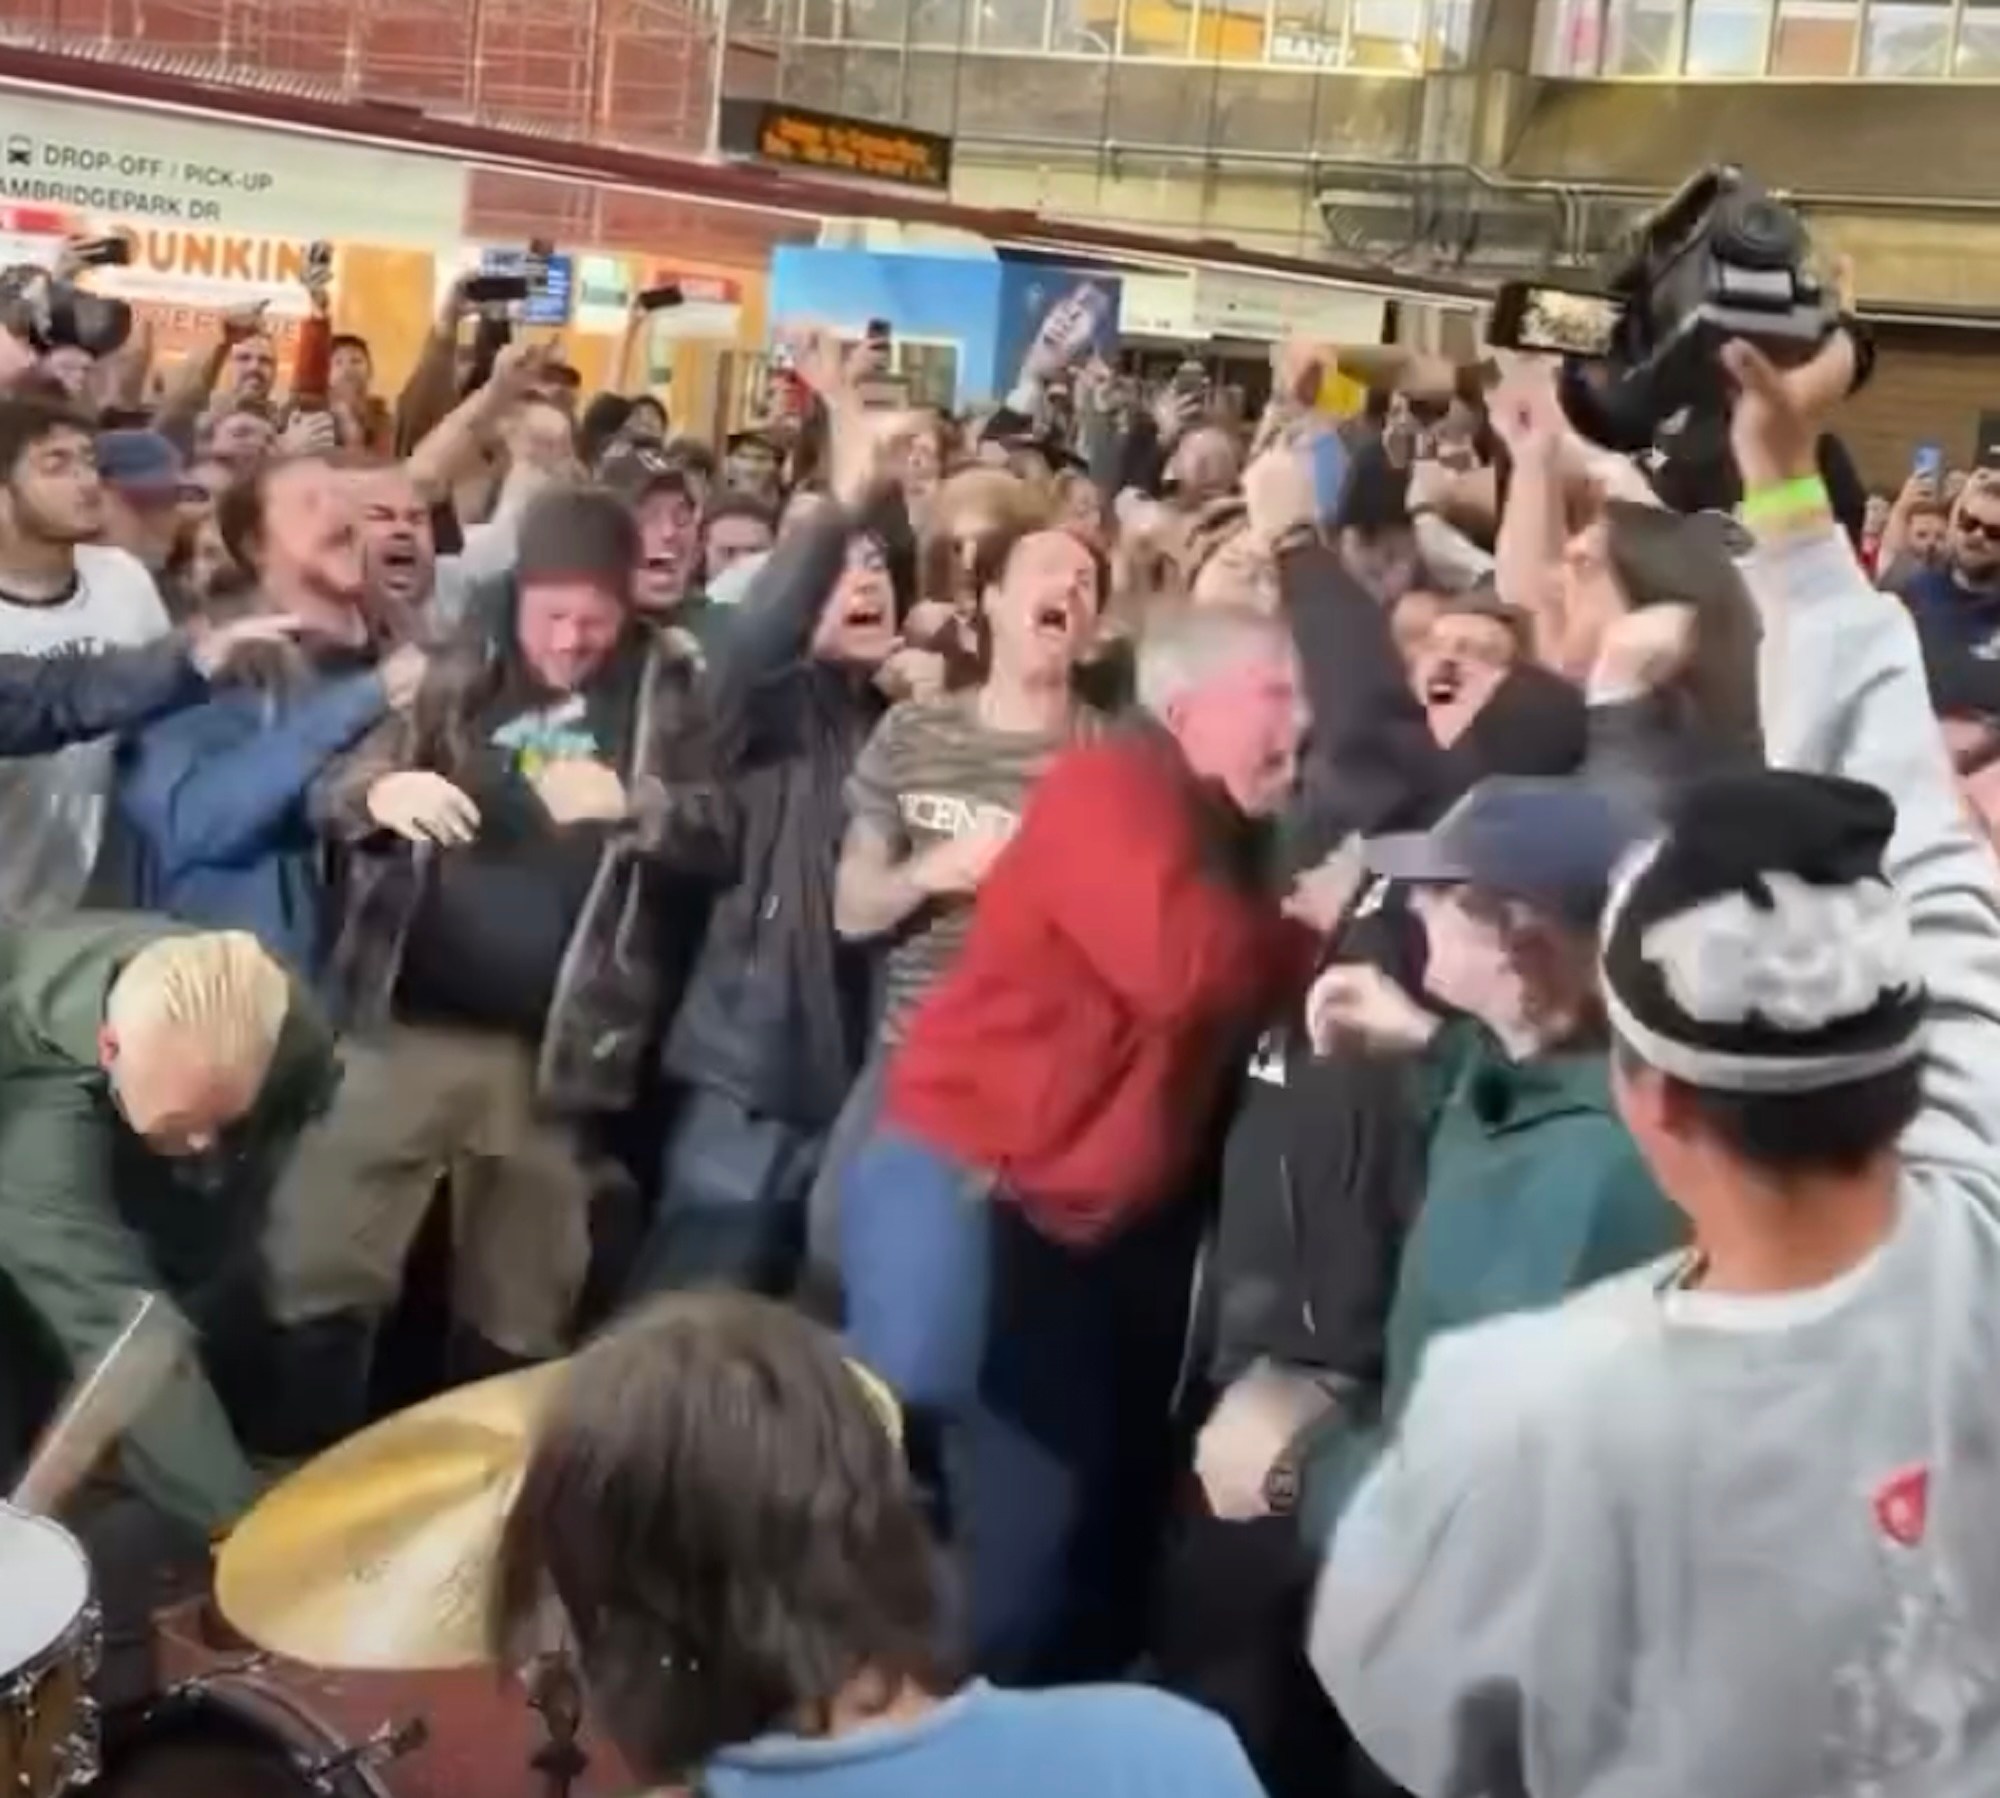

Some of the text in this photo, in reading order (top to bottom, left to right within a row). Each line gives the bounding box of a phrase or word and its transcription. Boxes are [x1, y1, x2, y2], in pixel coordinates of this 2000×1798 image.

[43, 143, 163, 178] DROP-OFF
[184, 163, 273, 192] PICK-UP
[188, 199, 221, 220] DR
